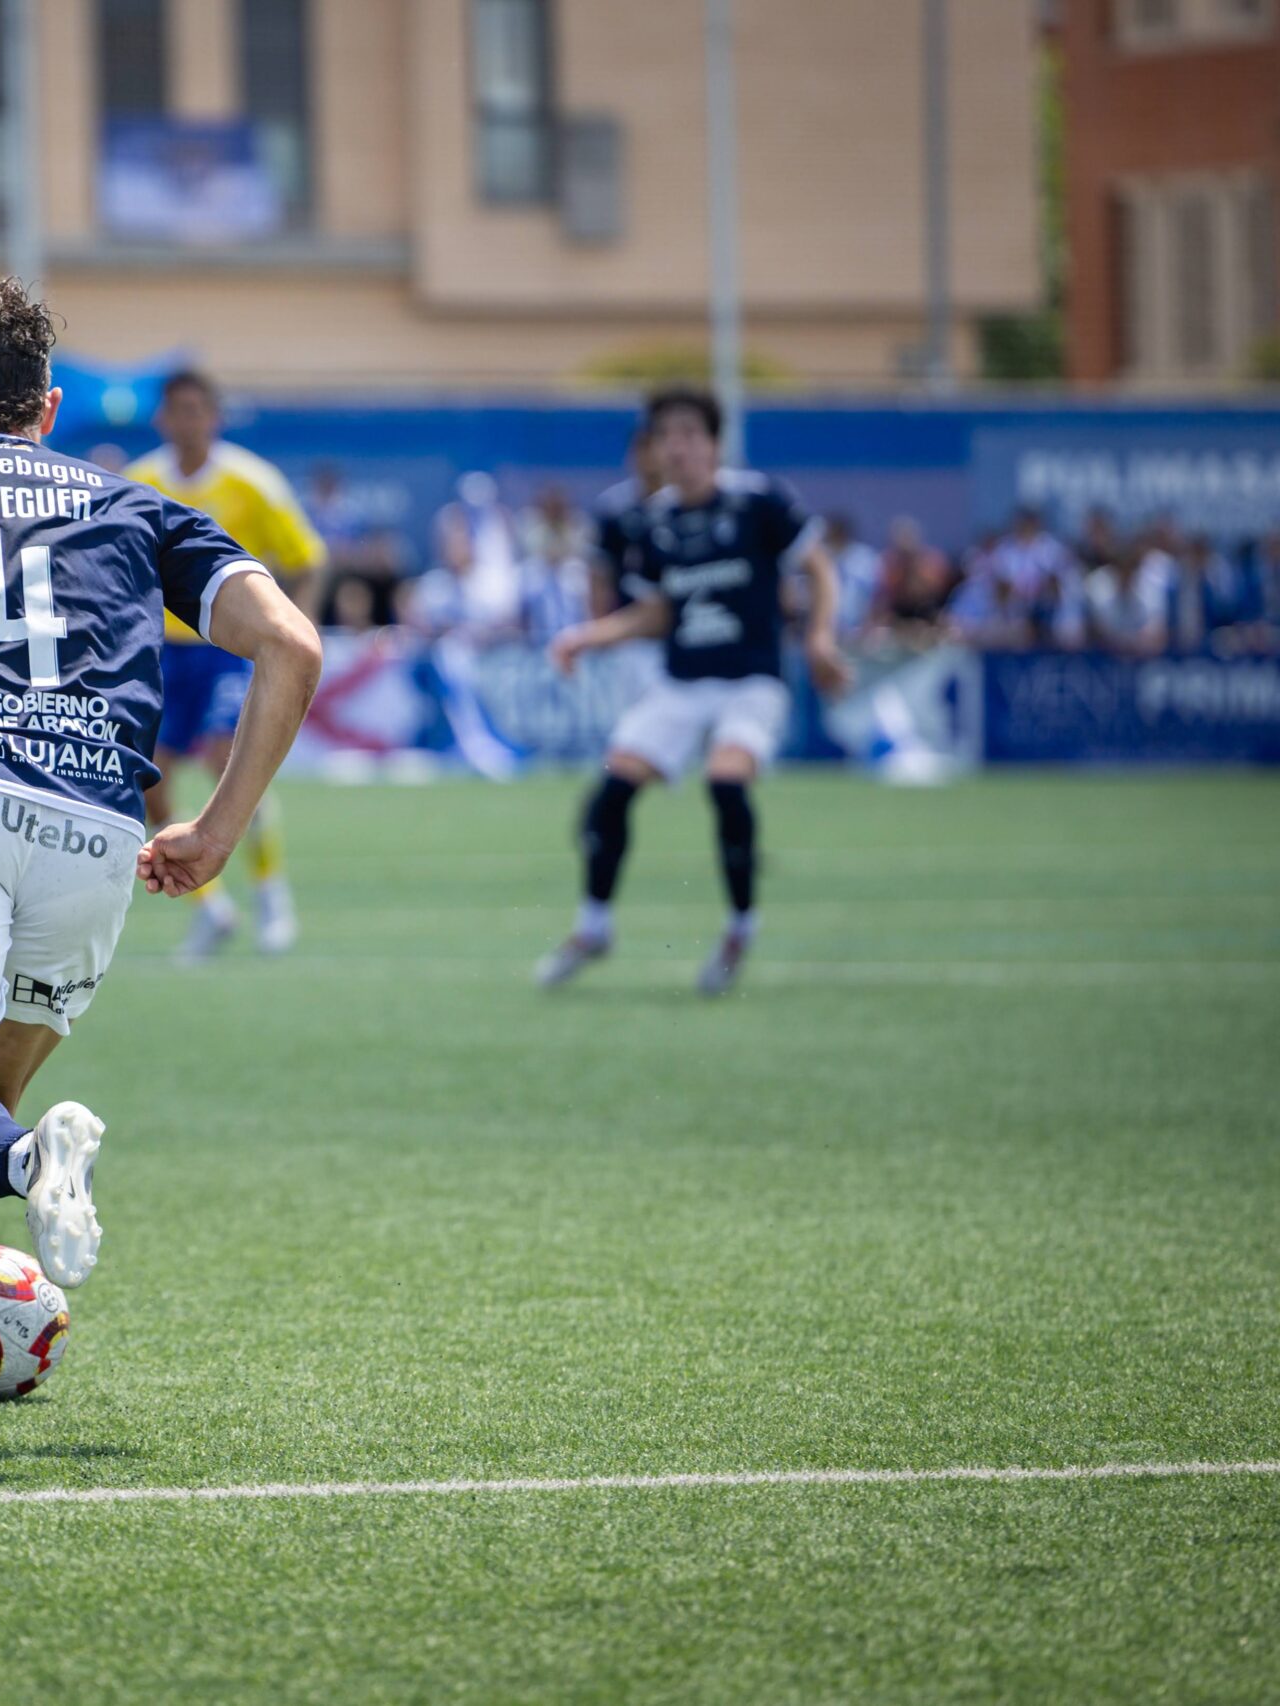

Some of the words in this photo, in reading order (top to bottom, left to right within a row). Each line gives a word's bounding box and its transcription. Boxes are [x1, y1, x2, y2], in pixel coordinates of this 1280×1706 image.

[8, 734, 123, 776] LUJAMA
[56, 769, 124, 785] INMOBILIARIO
[1, 797, 108, 858] Utebo
